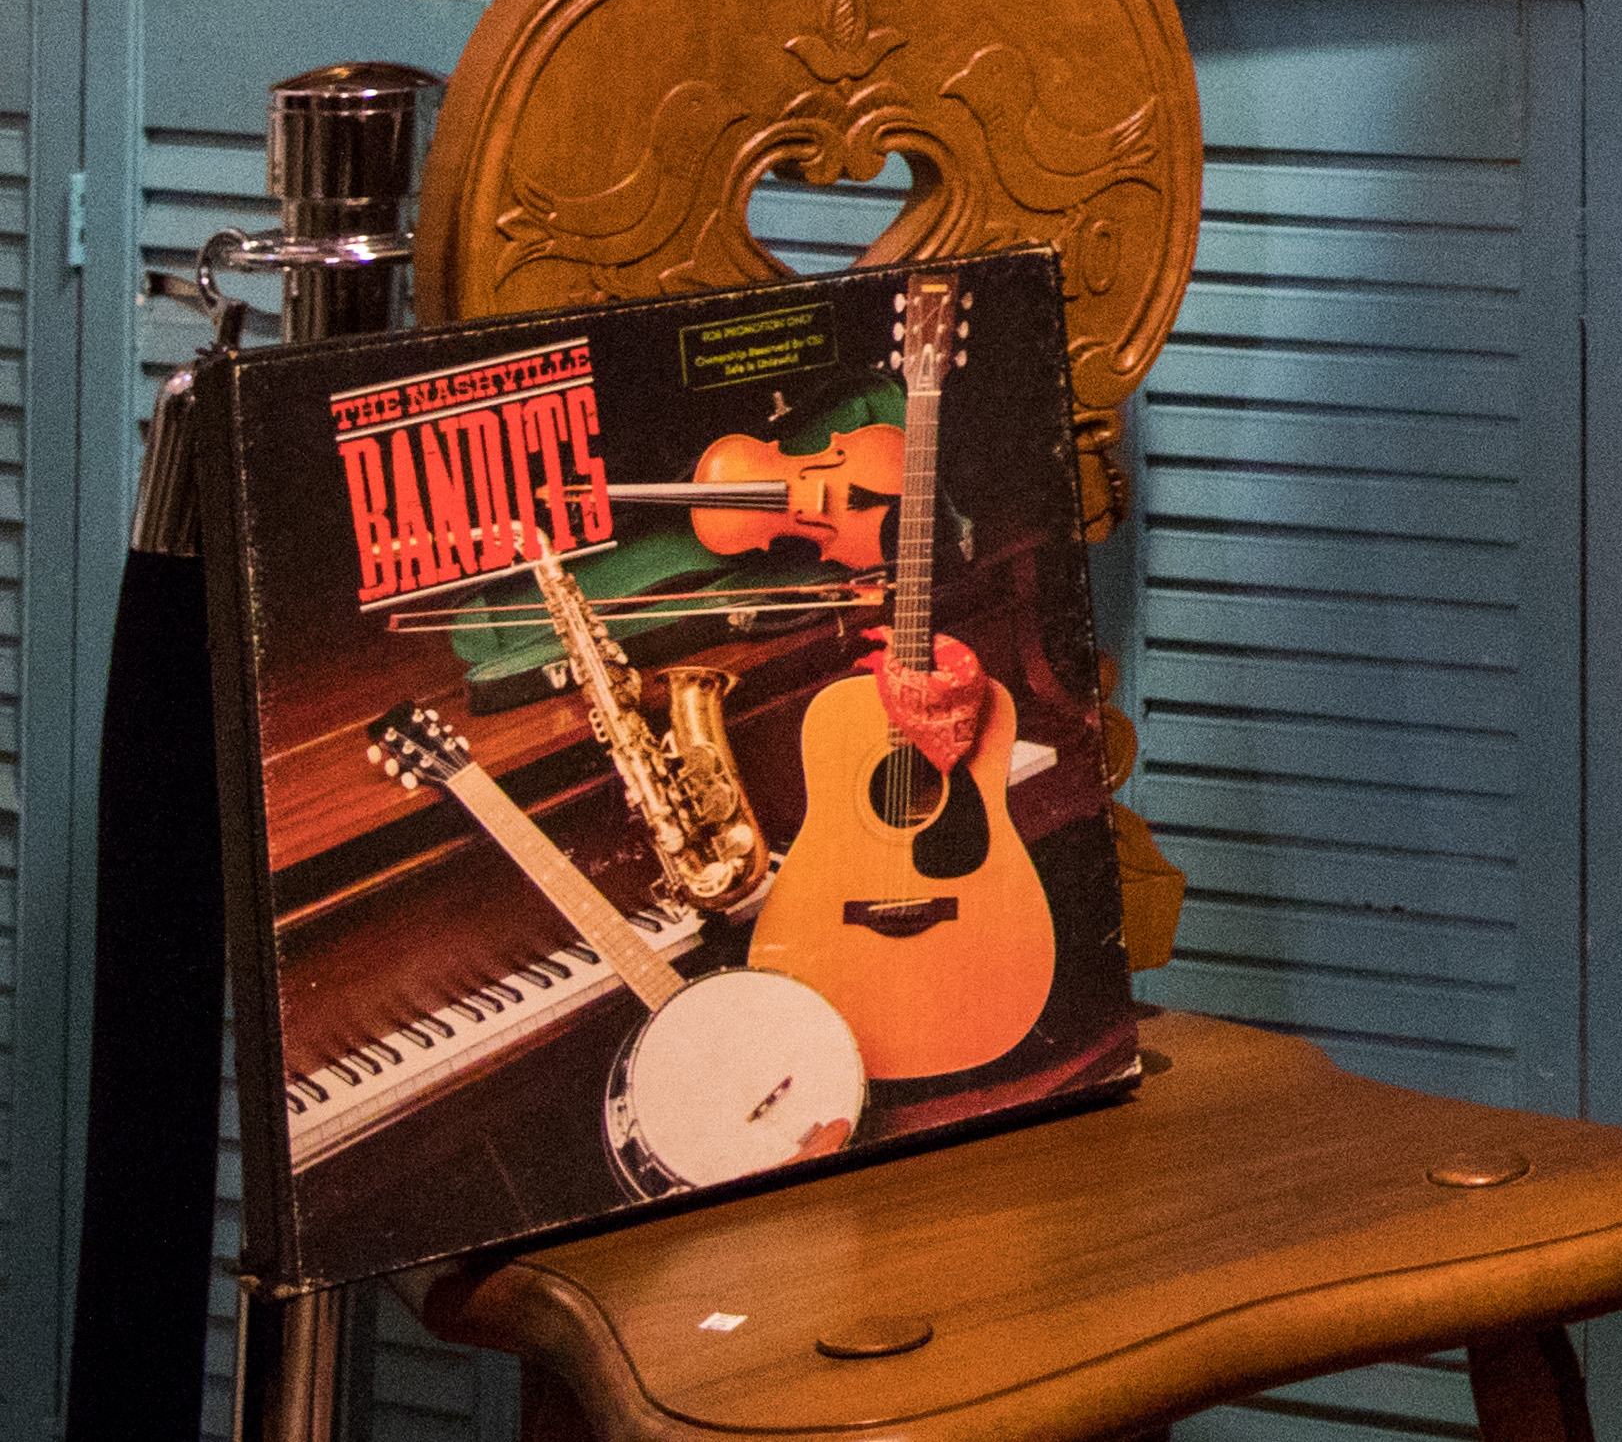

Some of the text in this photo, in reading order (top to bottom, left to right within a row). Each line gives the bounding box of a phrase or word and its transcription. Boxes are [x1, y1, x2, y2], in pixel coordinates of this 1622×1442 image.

[331, 346, 594, 431] THE NASHVILLE
[340, 386, 615, 606] BANDITS
